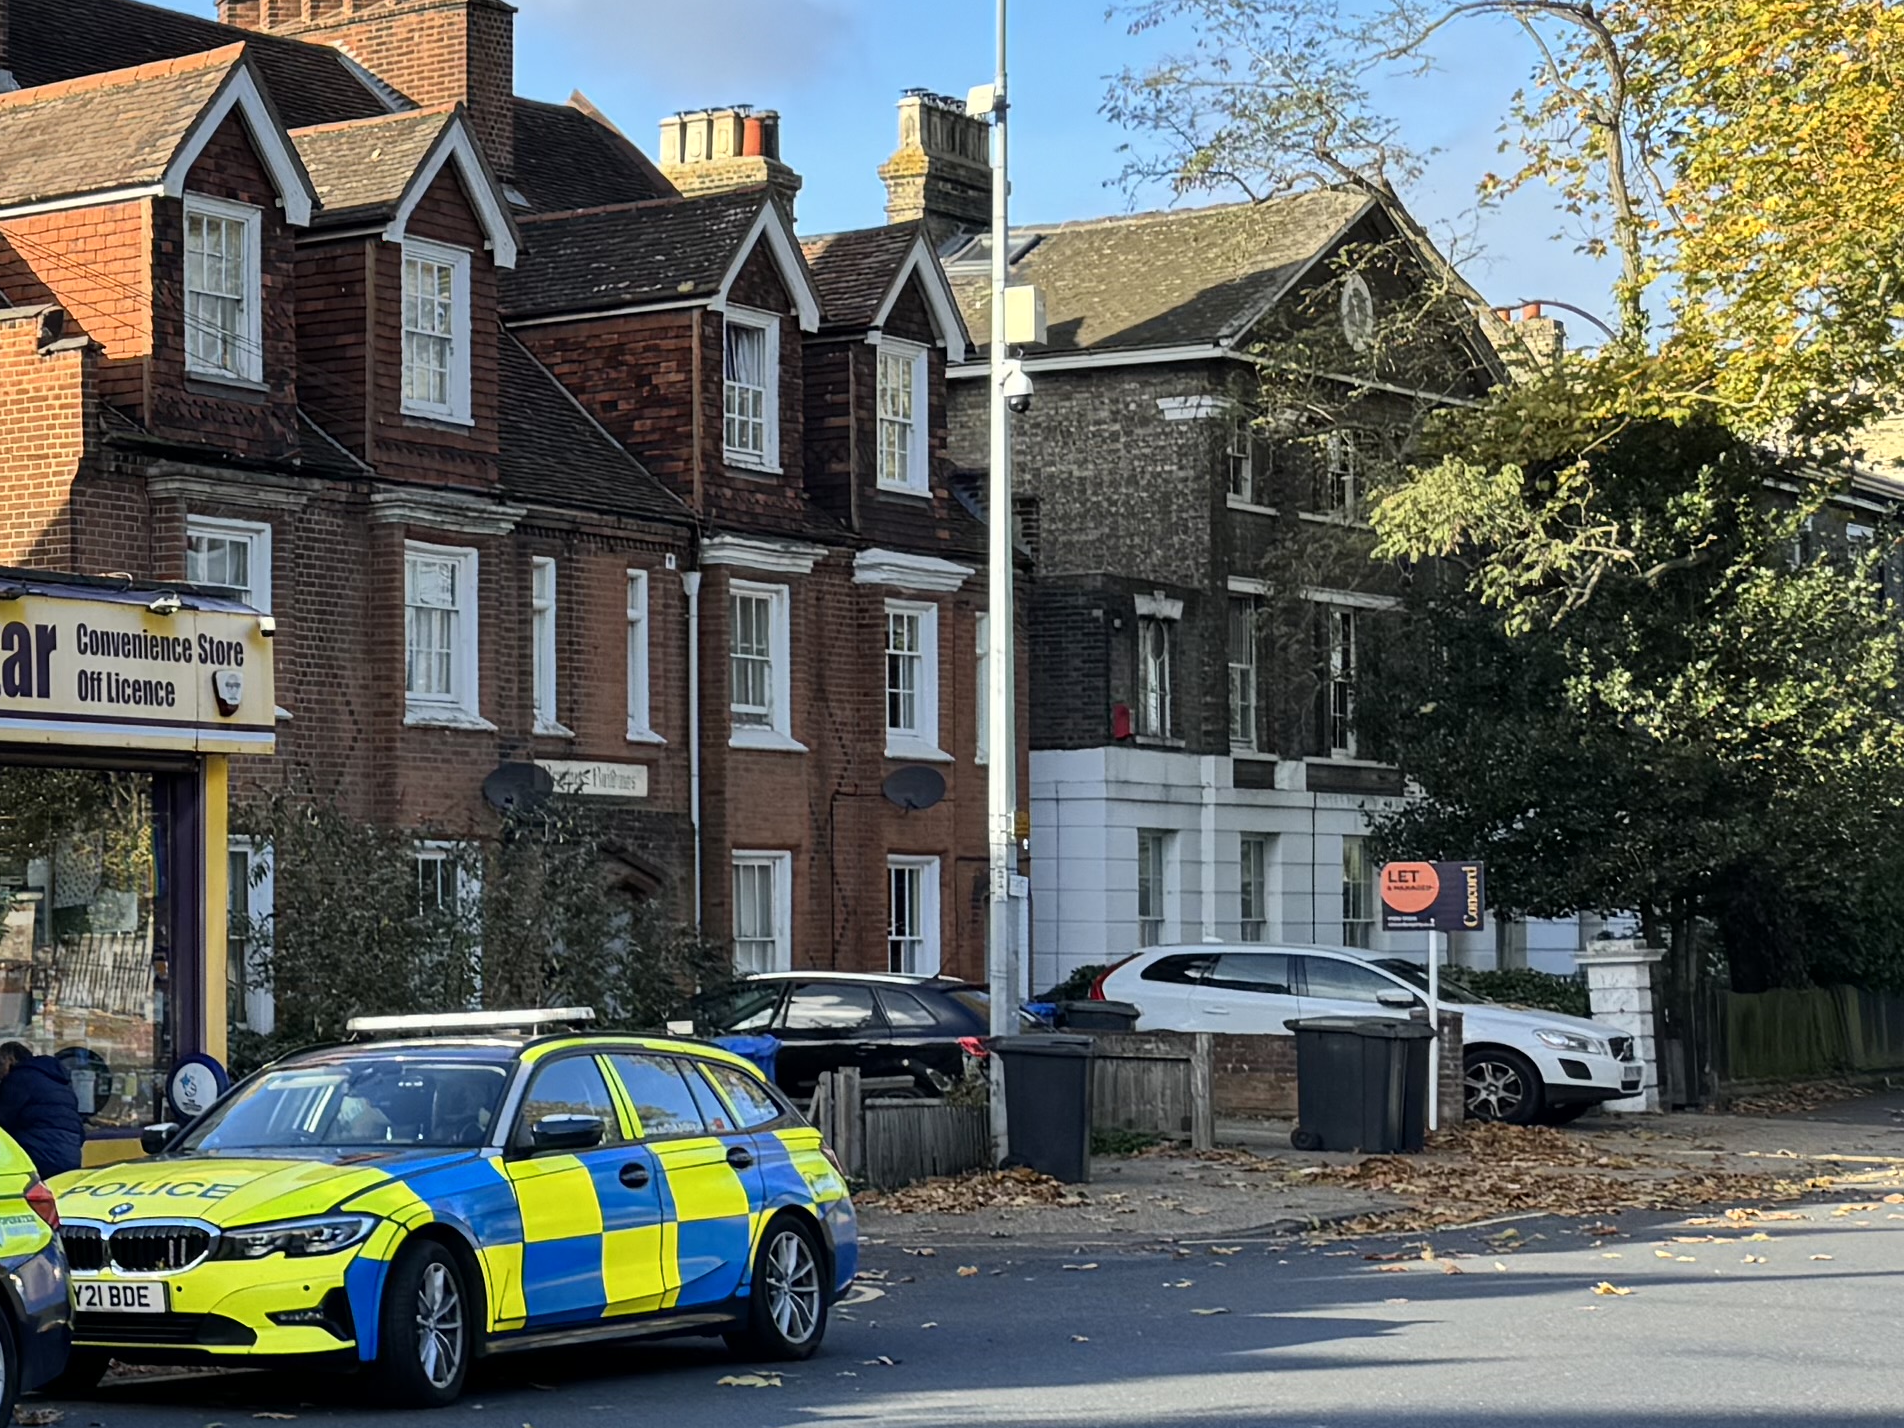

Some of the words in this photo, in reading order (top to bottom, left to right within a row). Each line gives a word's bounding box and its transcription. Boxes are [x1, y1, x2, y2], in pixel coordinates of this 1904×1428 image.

[76, 623, 193, 663] Convenience
[197, 633, 244, 667] Store
[77, 669, 103, 702] Off
[106, 671, 175, 707] Licence
[1388, 870, 1419, 883] LET
[1461, 866, 1478, 928] Concord
[58, 1181, 241, 1199] POLICE
[72, 1285, 103, 1307] Y21
[108, 1285, 151, 1307] BDE
